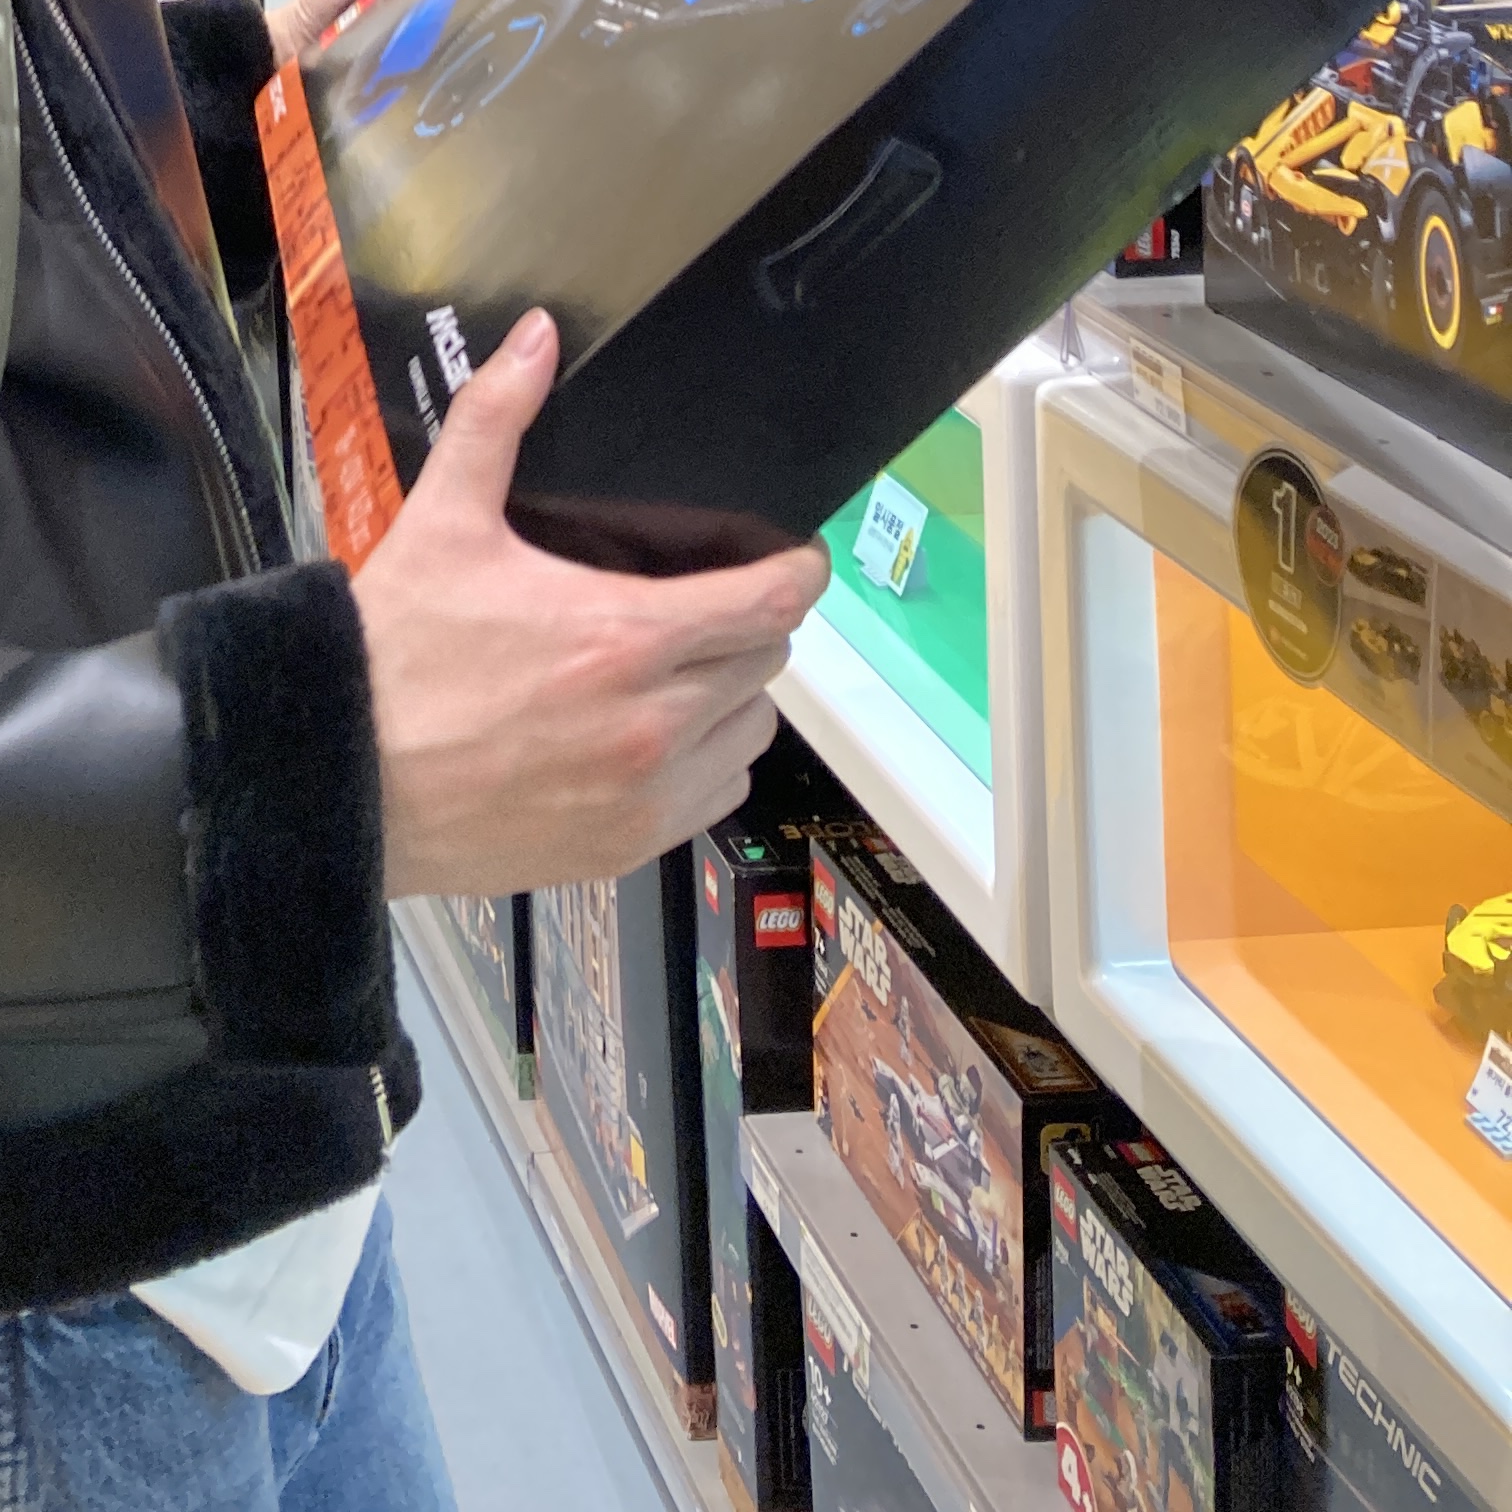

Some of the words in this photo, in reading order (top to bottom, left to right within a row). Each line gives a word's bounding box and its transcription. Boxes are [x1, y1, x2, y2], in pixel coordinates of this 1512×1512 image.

[758, 908, 803, 931] LEGO
[815, 880, 835, 920] LEGO
[839, 896, 891, 980] STAR
[839, 924, 891, 1007] WARS
[1054, 1186, 1075, 1225] LEGO
[1080, 1208, 1133, 1292] STAR
[1080, 1233, 1133, 1317] WARS
[808, 1354, 832, 1406] 10+
[1325, 1334, 1441, 1504] TECHNIC
